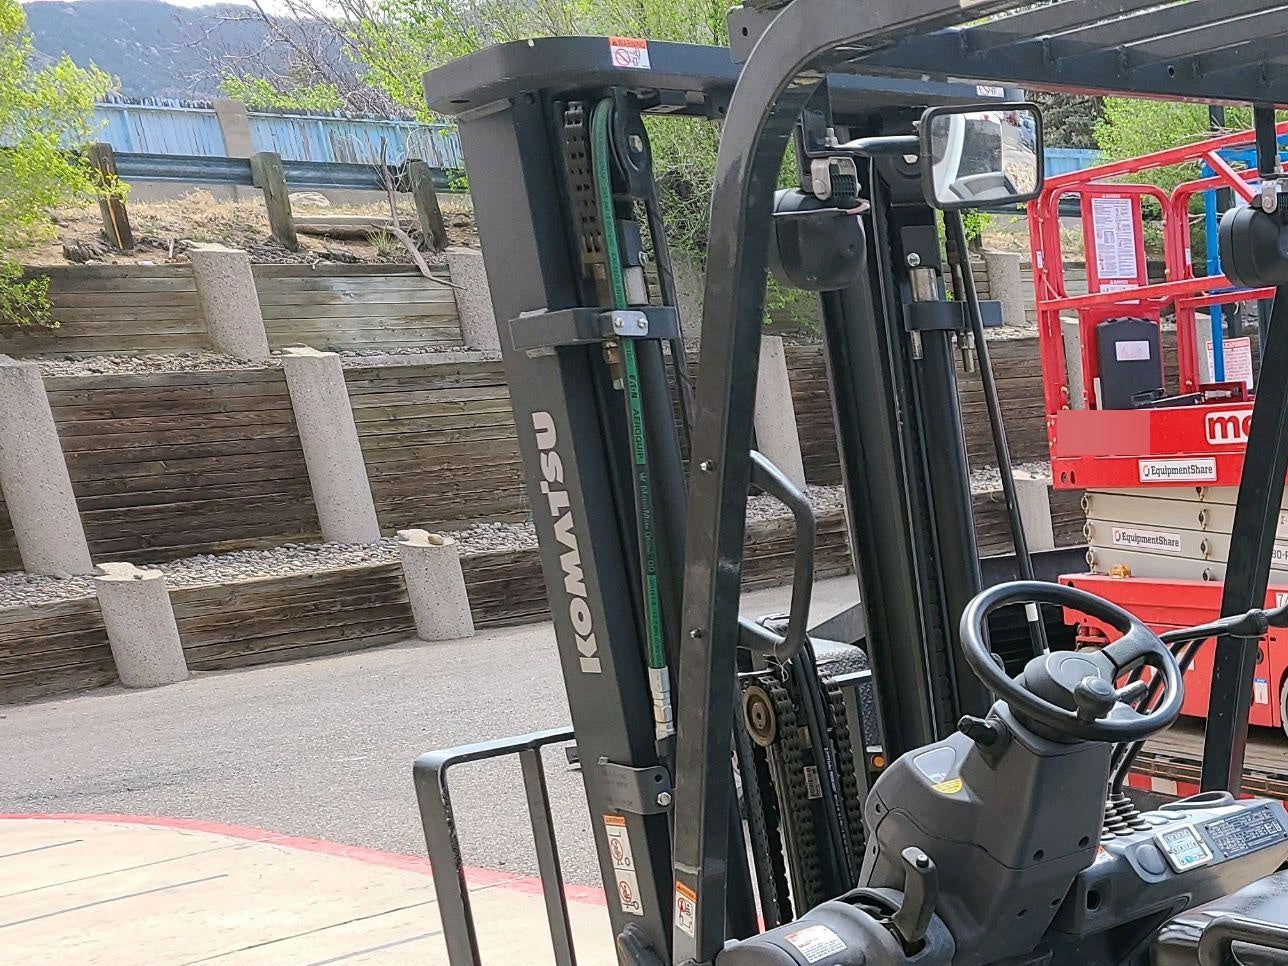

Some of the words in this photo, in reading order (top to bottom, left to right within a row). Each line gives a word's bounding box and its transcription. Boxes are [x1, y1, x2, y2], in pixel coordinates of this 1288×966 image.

[1151, 464, 1213, 480] EquipmentShare
[532, 411, 602, 673] KOMATSU
[1121, 533, 1180, 548] EquipmentShare
